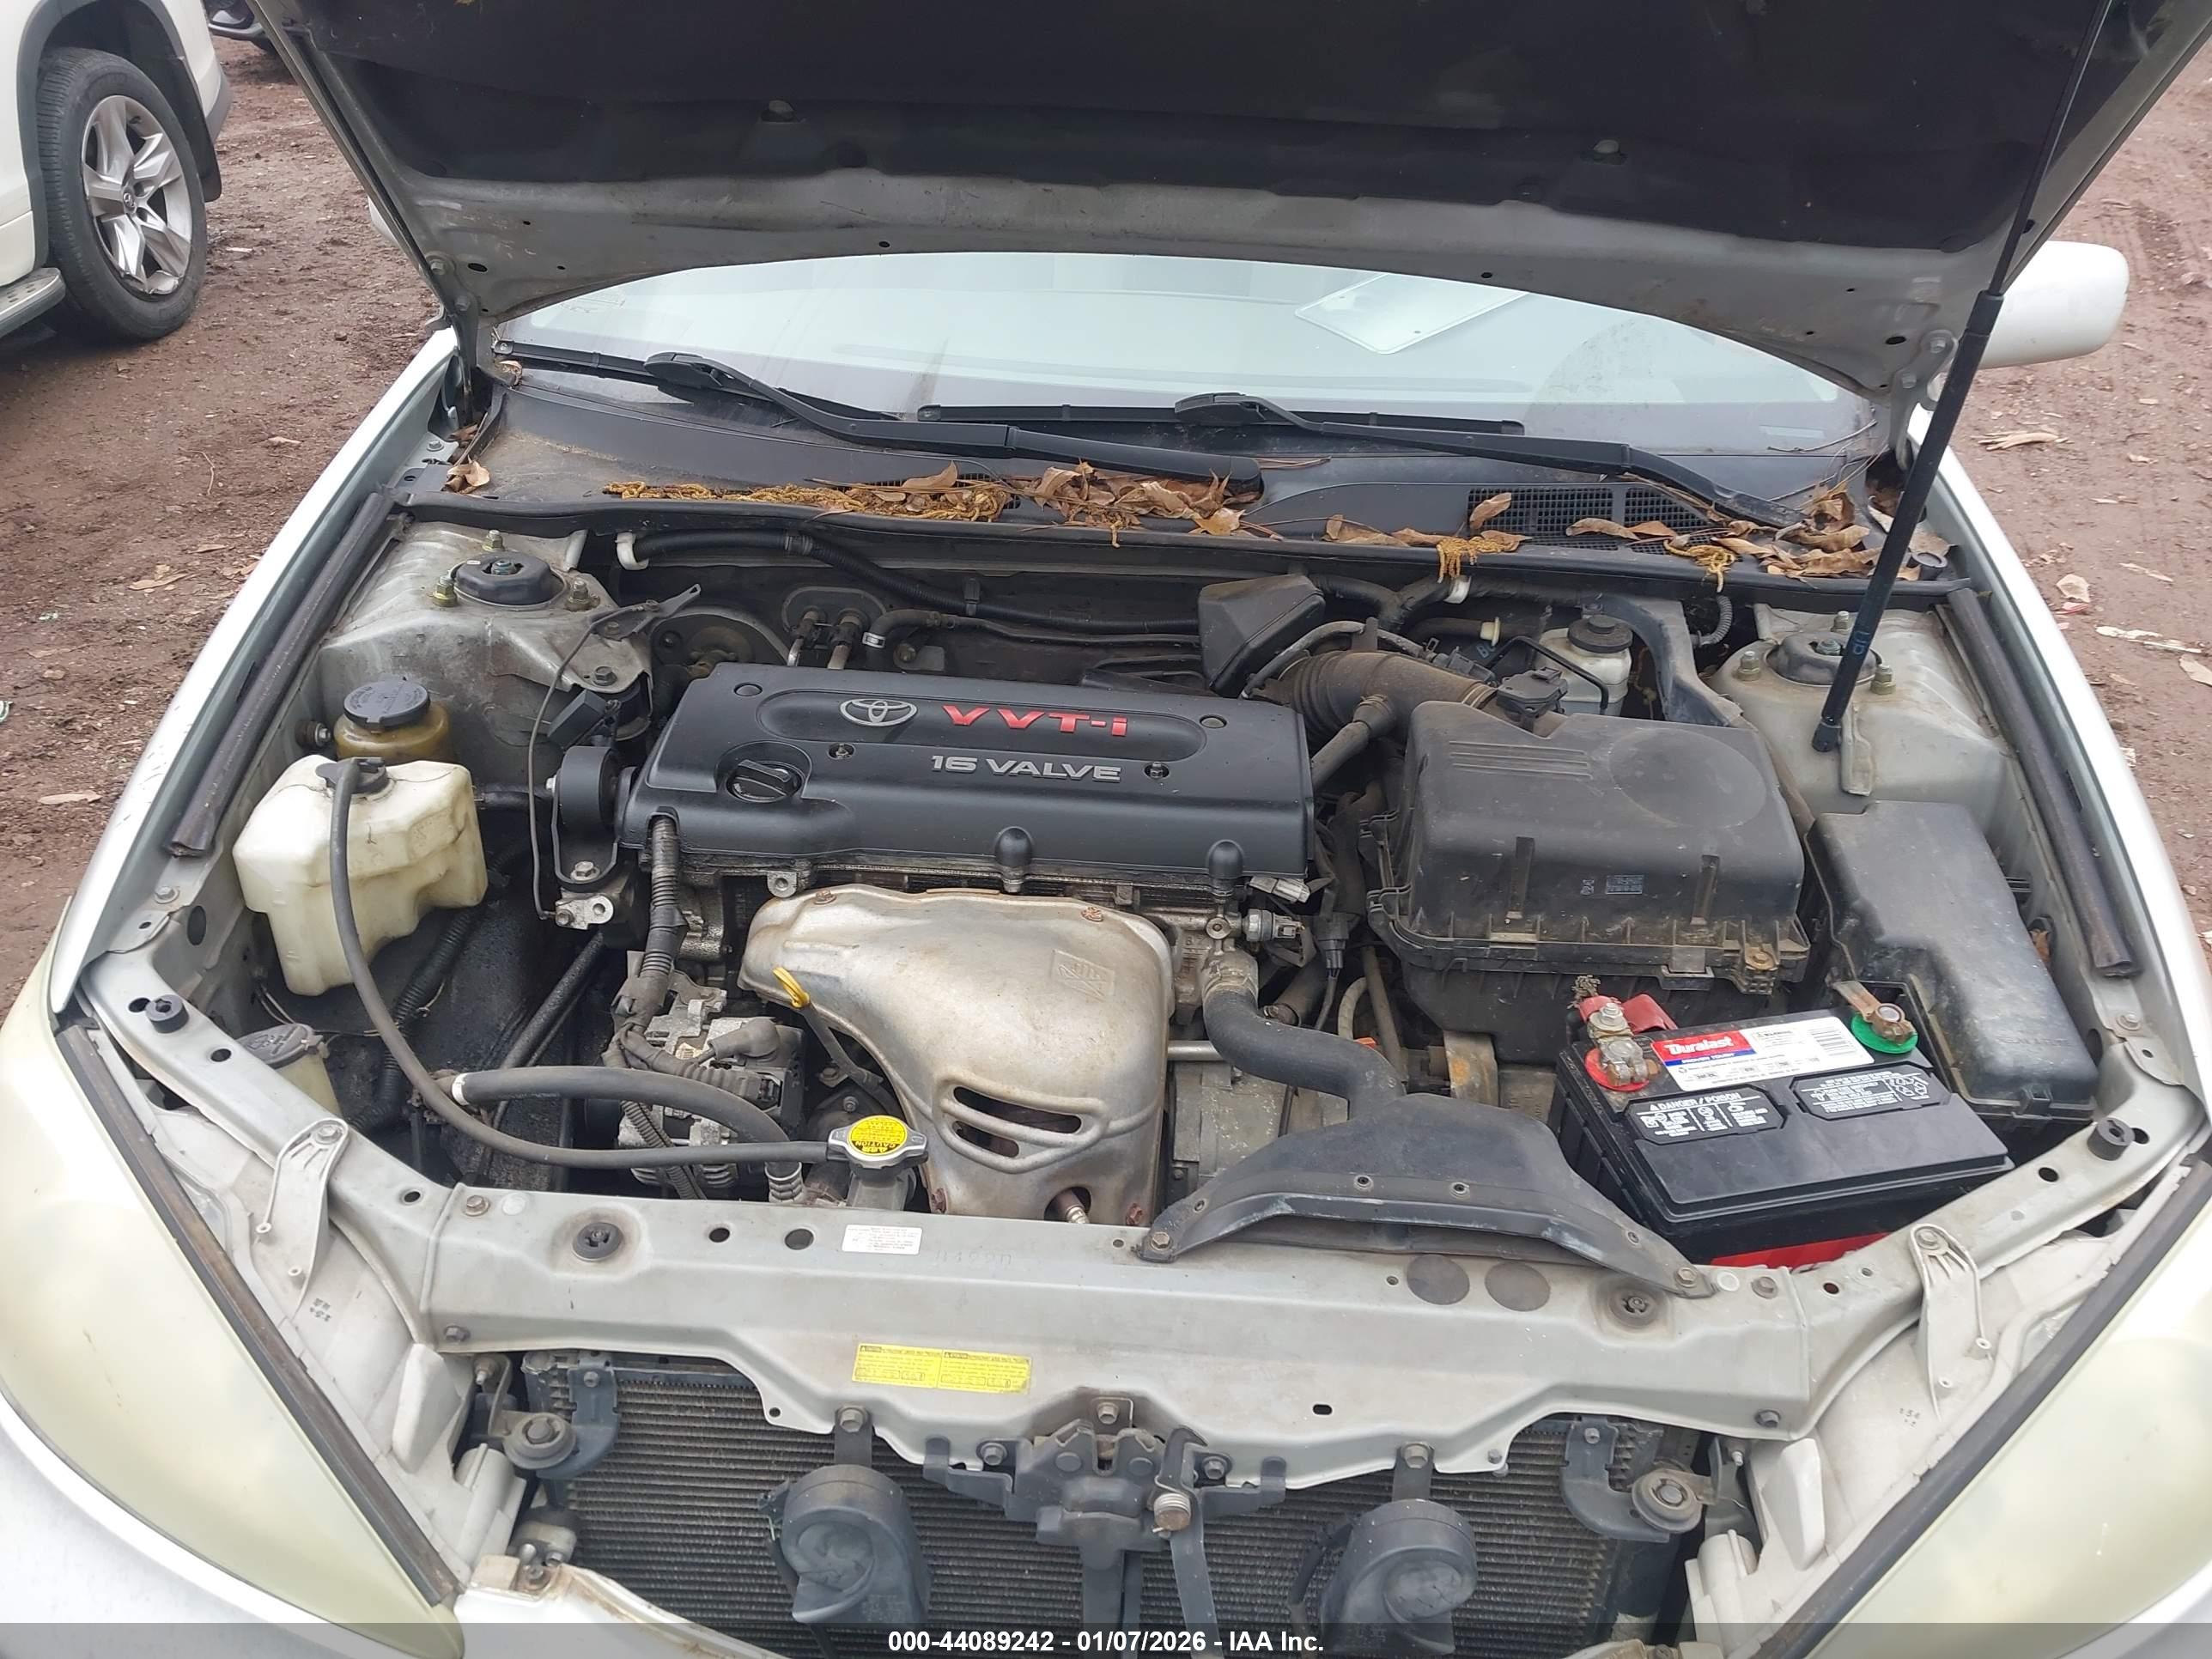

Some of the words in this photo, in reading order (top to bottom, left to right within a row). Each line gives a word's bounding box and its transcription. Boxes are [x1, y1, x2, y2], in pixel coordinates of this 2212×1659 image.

[942, 705, 1127, 737] VVT-i
[932, 755, 978, 772] 16
[986, 758, 1121, 783] VALVE
[1663, 1036, 1735, 1055] Duralast
[1657, 1098, 1698, 1111] DANGER
[1705, 1092, 1743, 1103] POISON
[854, 1140, 896, 1149] CAUTION
